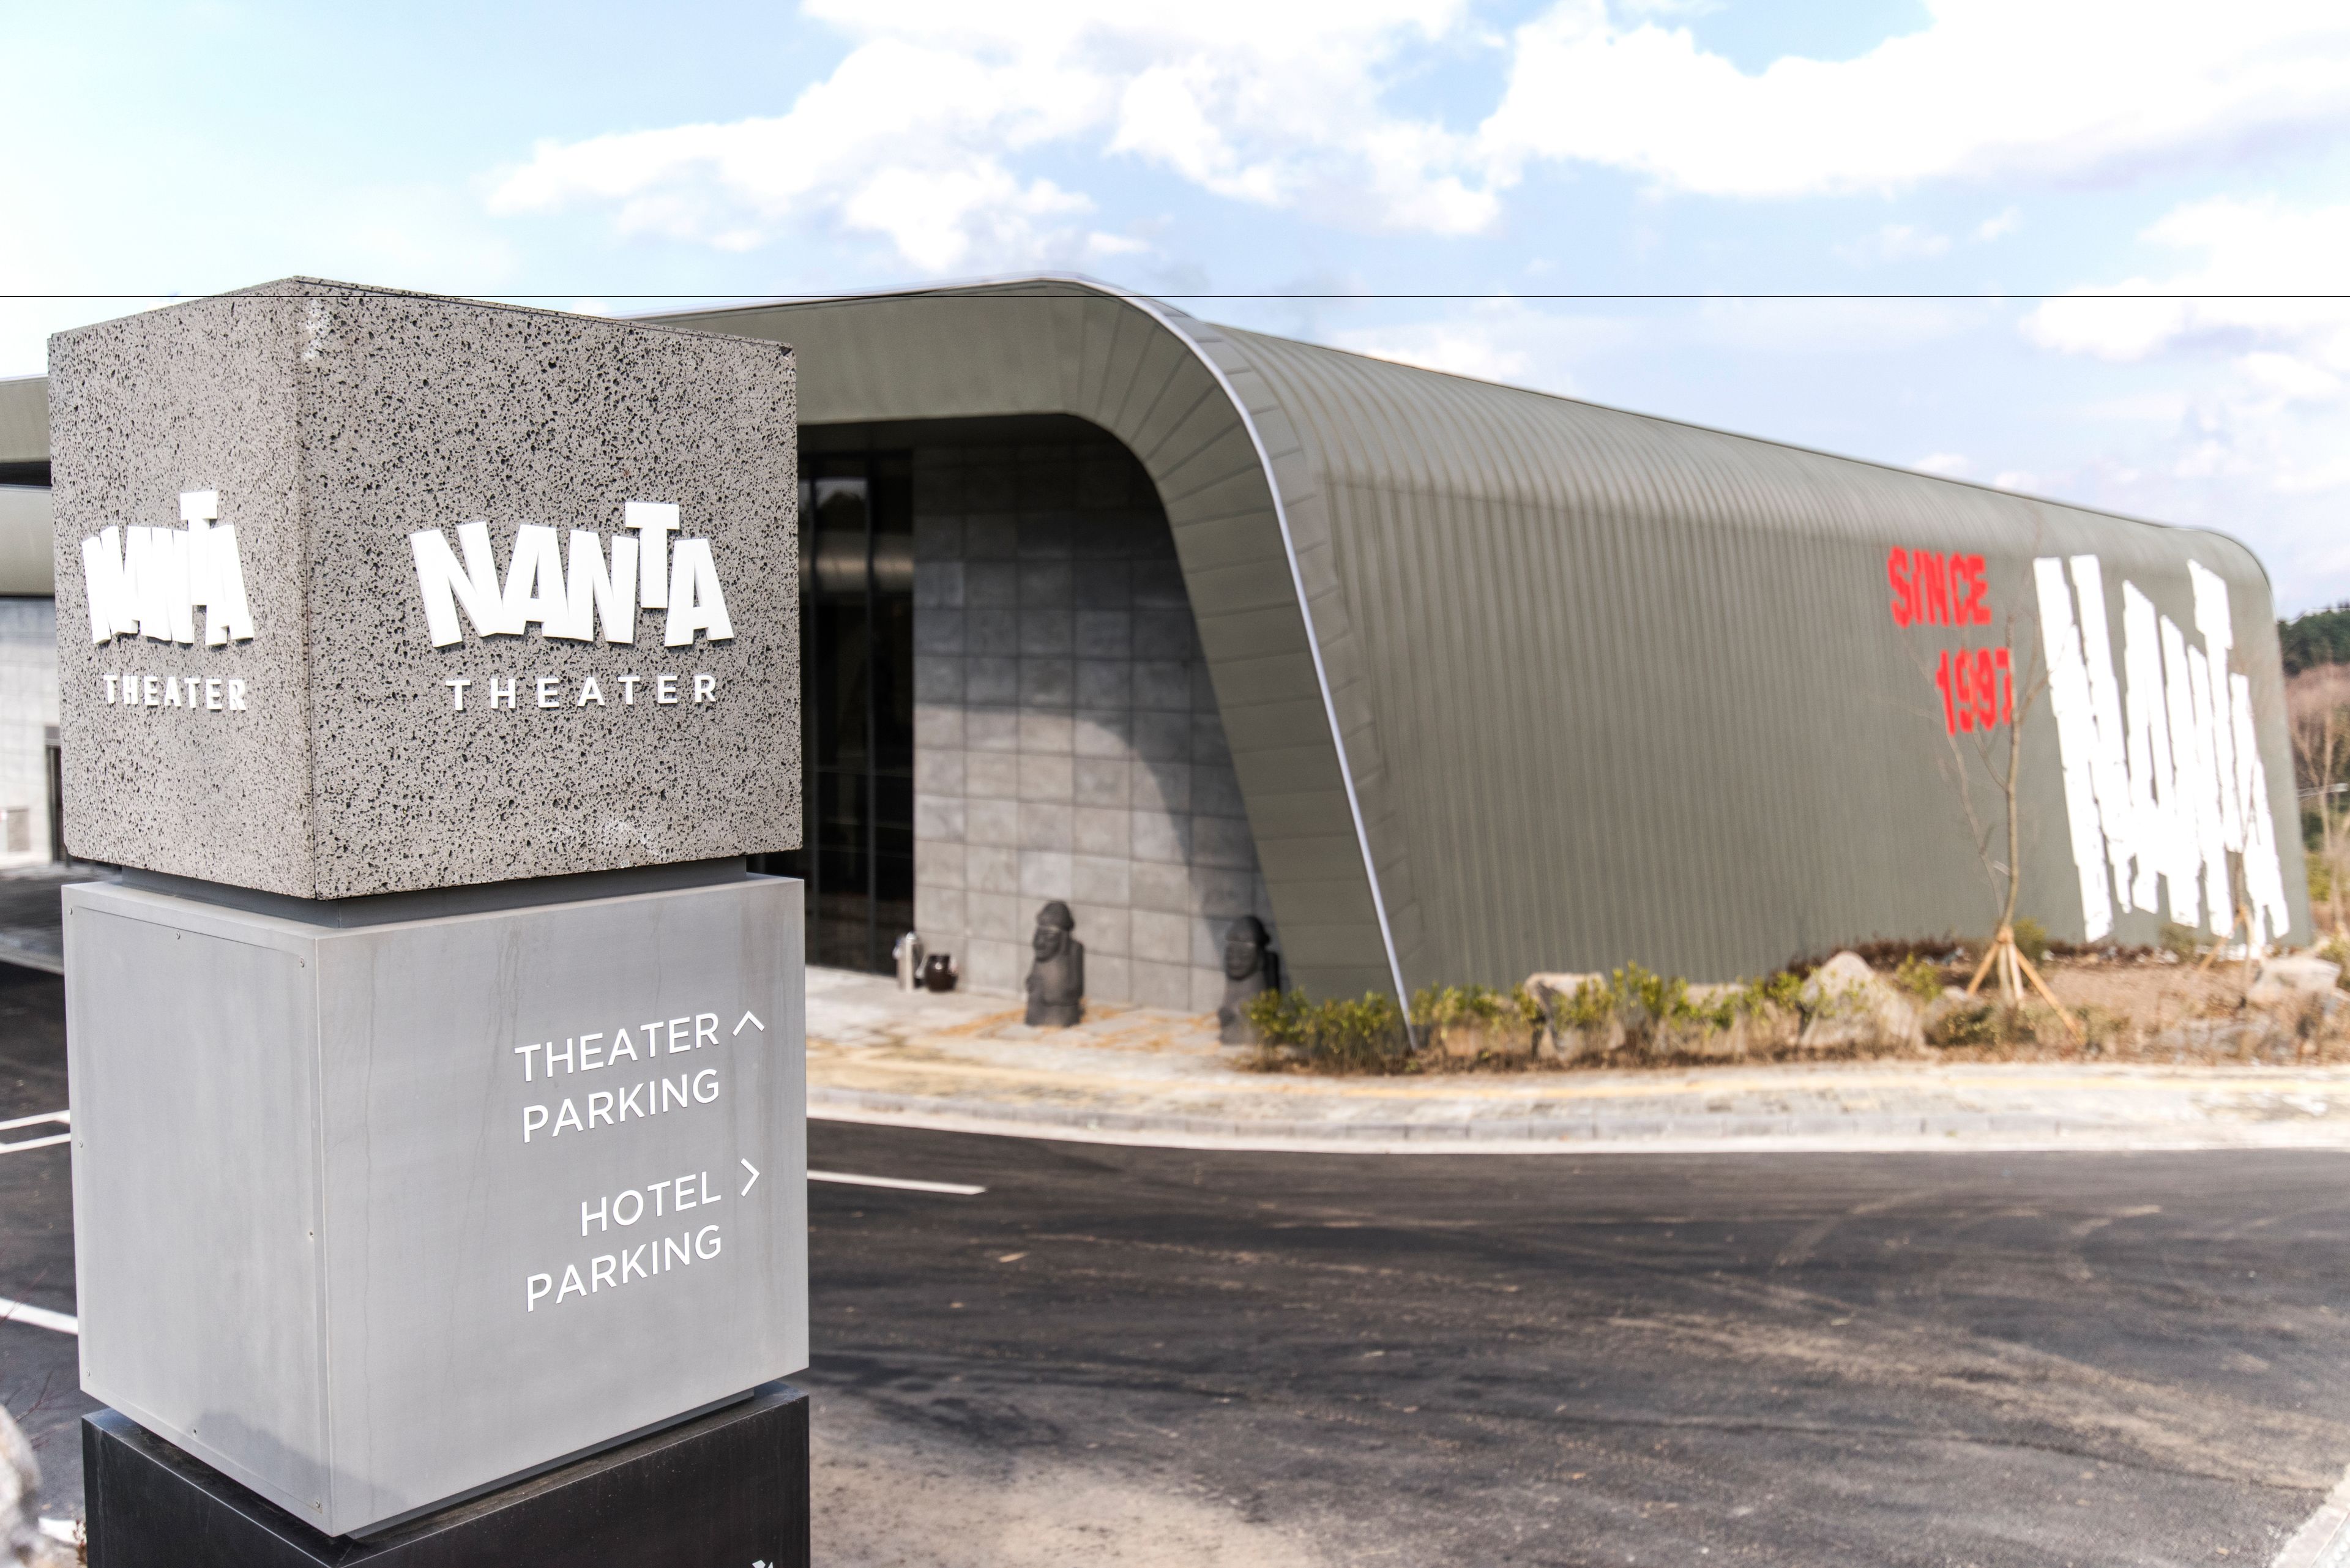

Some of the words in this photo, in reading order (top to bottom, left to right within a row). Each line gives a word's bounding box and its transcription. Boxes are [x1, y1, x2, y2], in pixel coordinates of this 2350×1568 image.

[409, 502, 734, 648] NANTA
[1889, 547, 1991, 628] SINCE
[103, 674, 247, 711] THEATER
[446, 674, 717, 711] THEATER
[1936, 646, 2013, 736] 1997
[514, 1013, 720, 1082] THEATER
[523, 1069, 719, 1143] PARKING
[581, 1171, 722, 1237] HOTEL
[526, 1225, 722, 1312] PARKING
